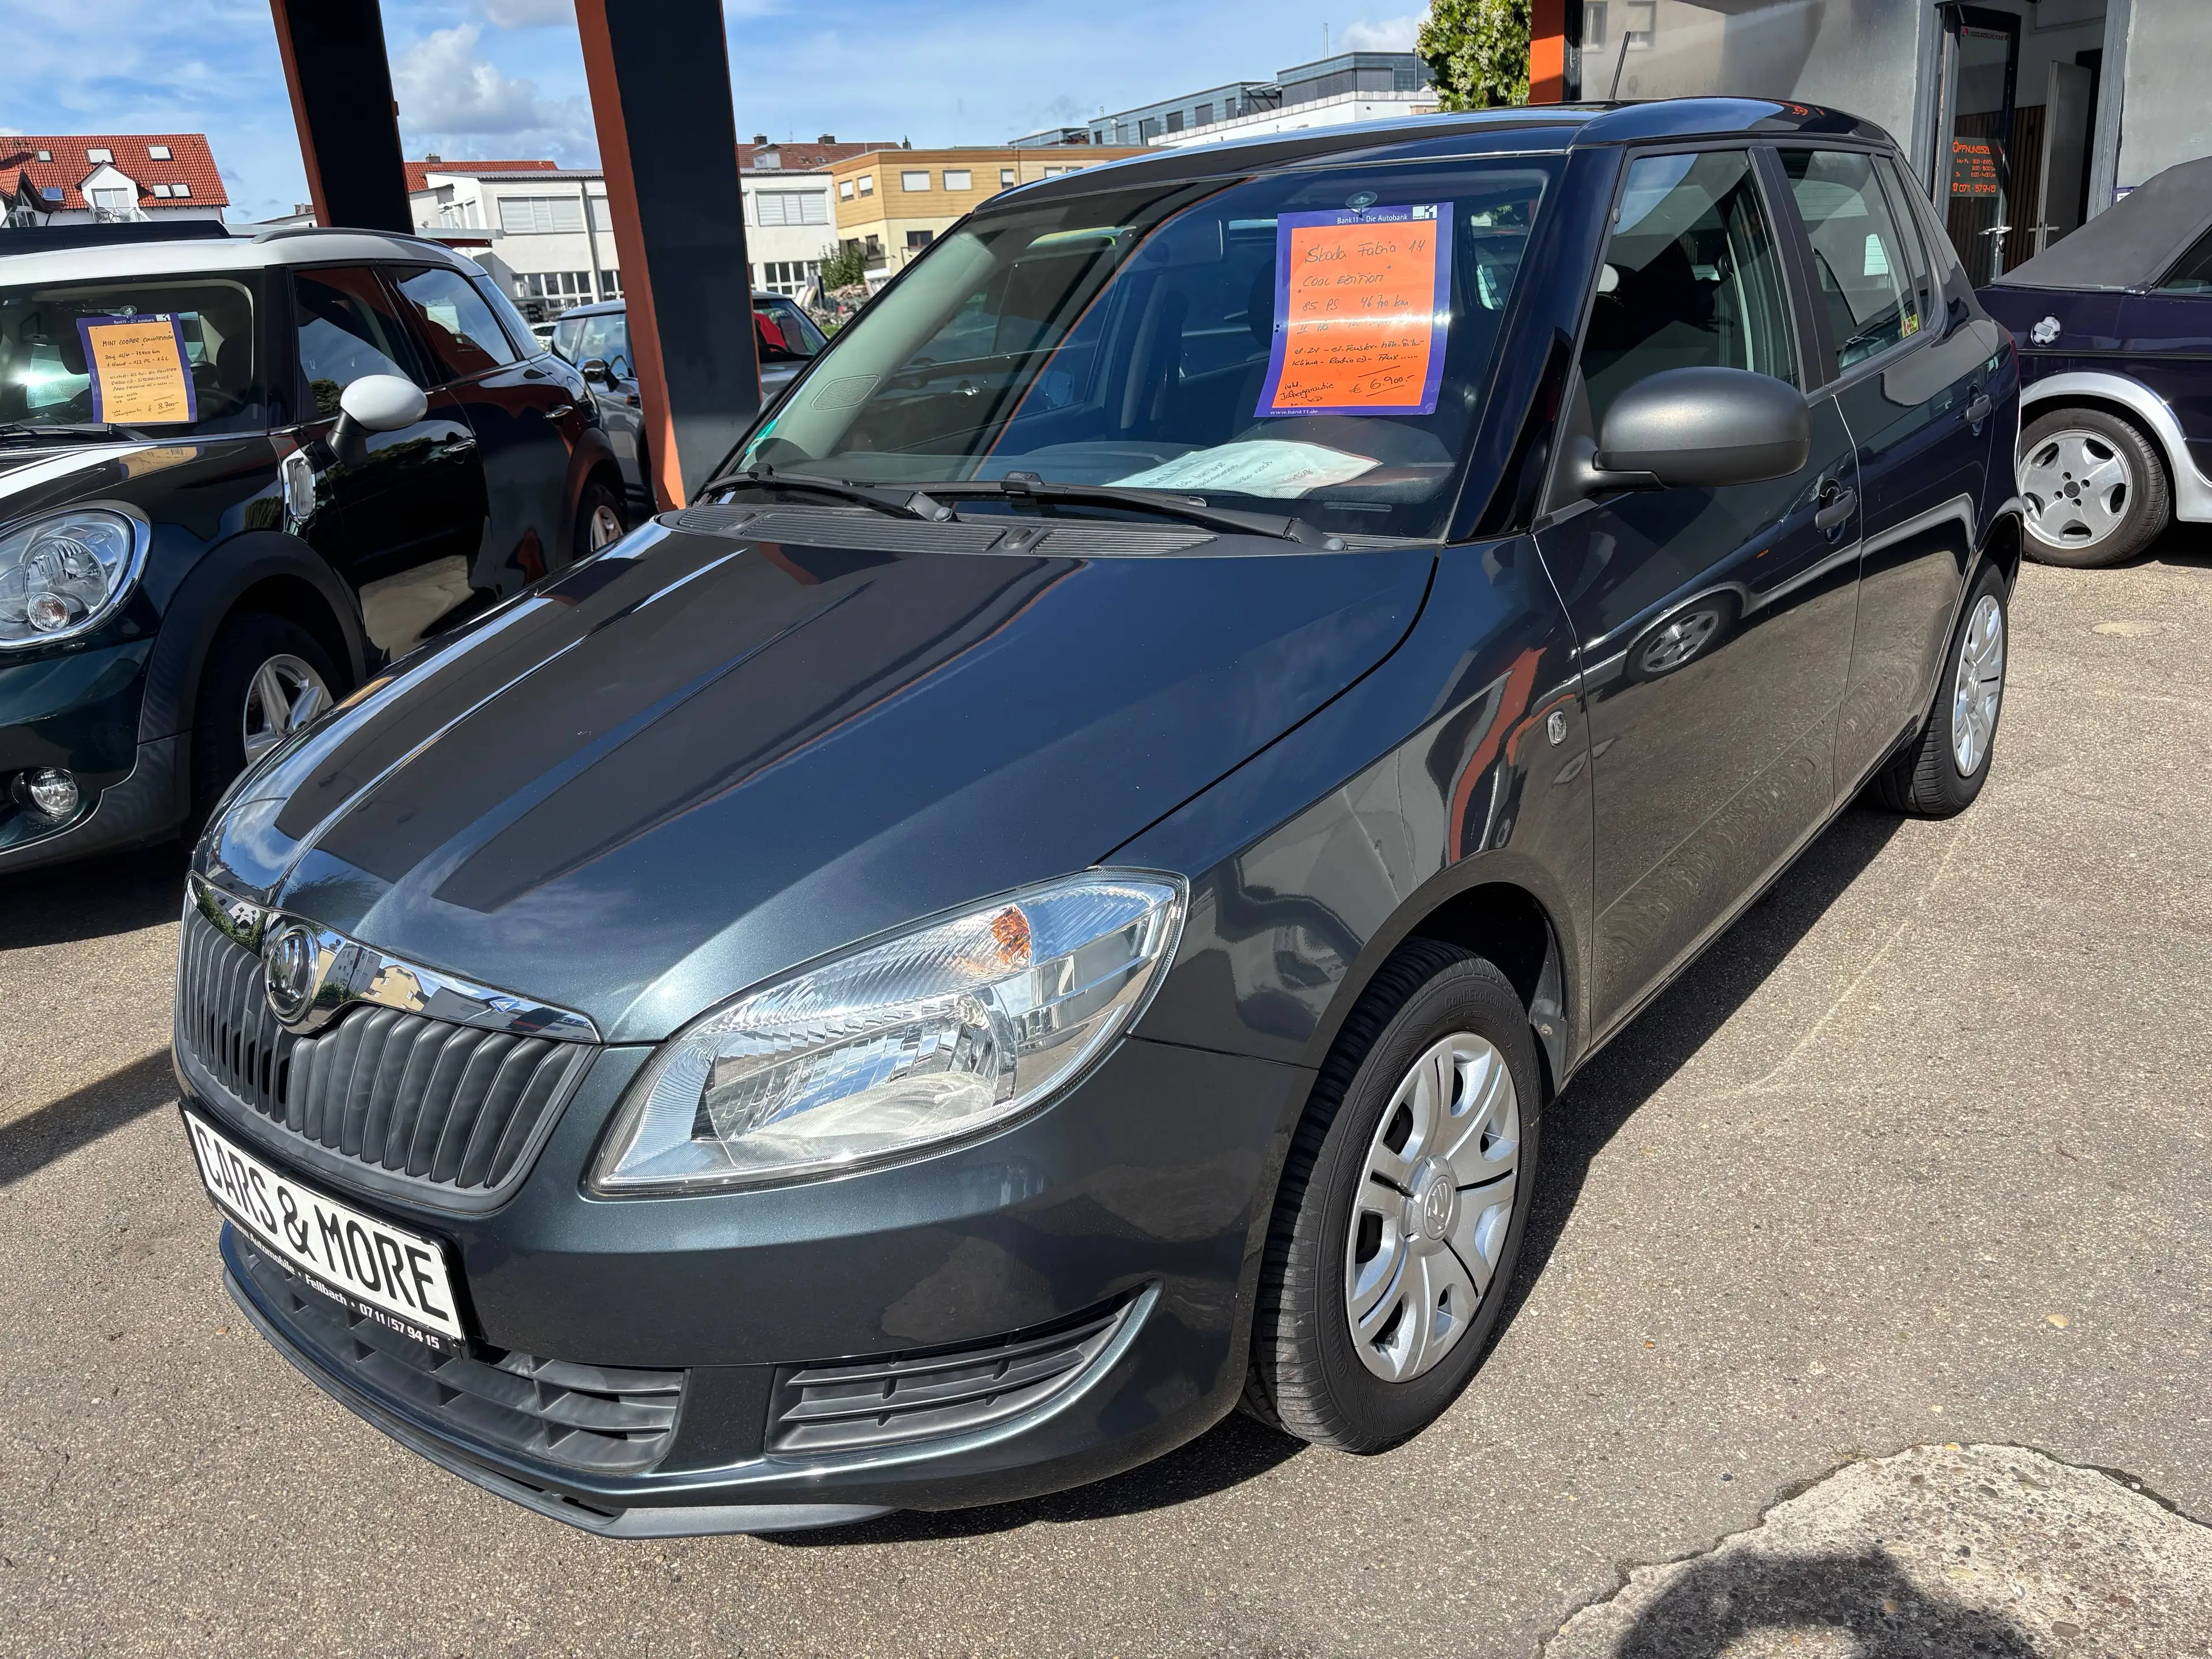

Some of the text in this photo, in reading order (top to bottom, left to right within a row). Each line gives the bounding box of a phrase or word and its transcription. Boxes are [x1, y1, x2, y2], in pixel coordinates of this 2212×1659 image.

[1377, 214, 1408, 222] Autobank
[1358, 241, 1396, 257] Fabia
[1408, 240, 1426, 252] 1.4
[1326, 298, 1339, 312] PS
[1394, 294, 1409, 307] km
[119, 338, 140, 346] COOPER
[195, 1123, 450, 1323] CARS & MORE
[250, 1233, 296, 1275] Automobile
[304, 1273, 348, 1306] Fellbach
